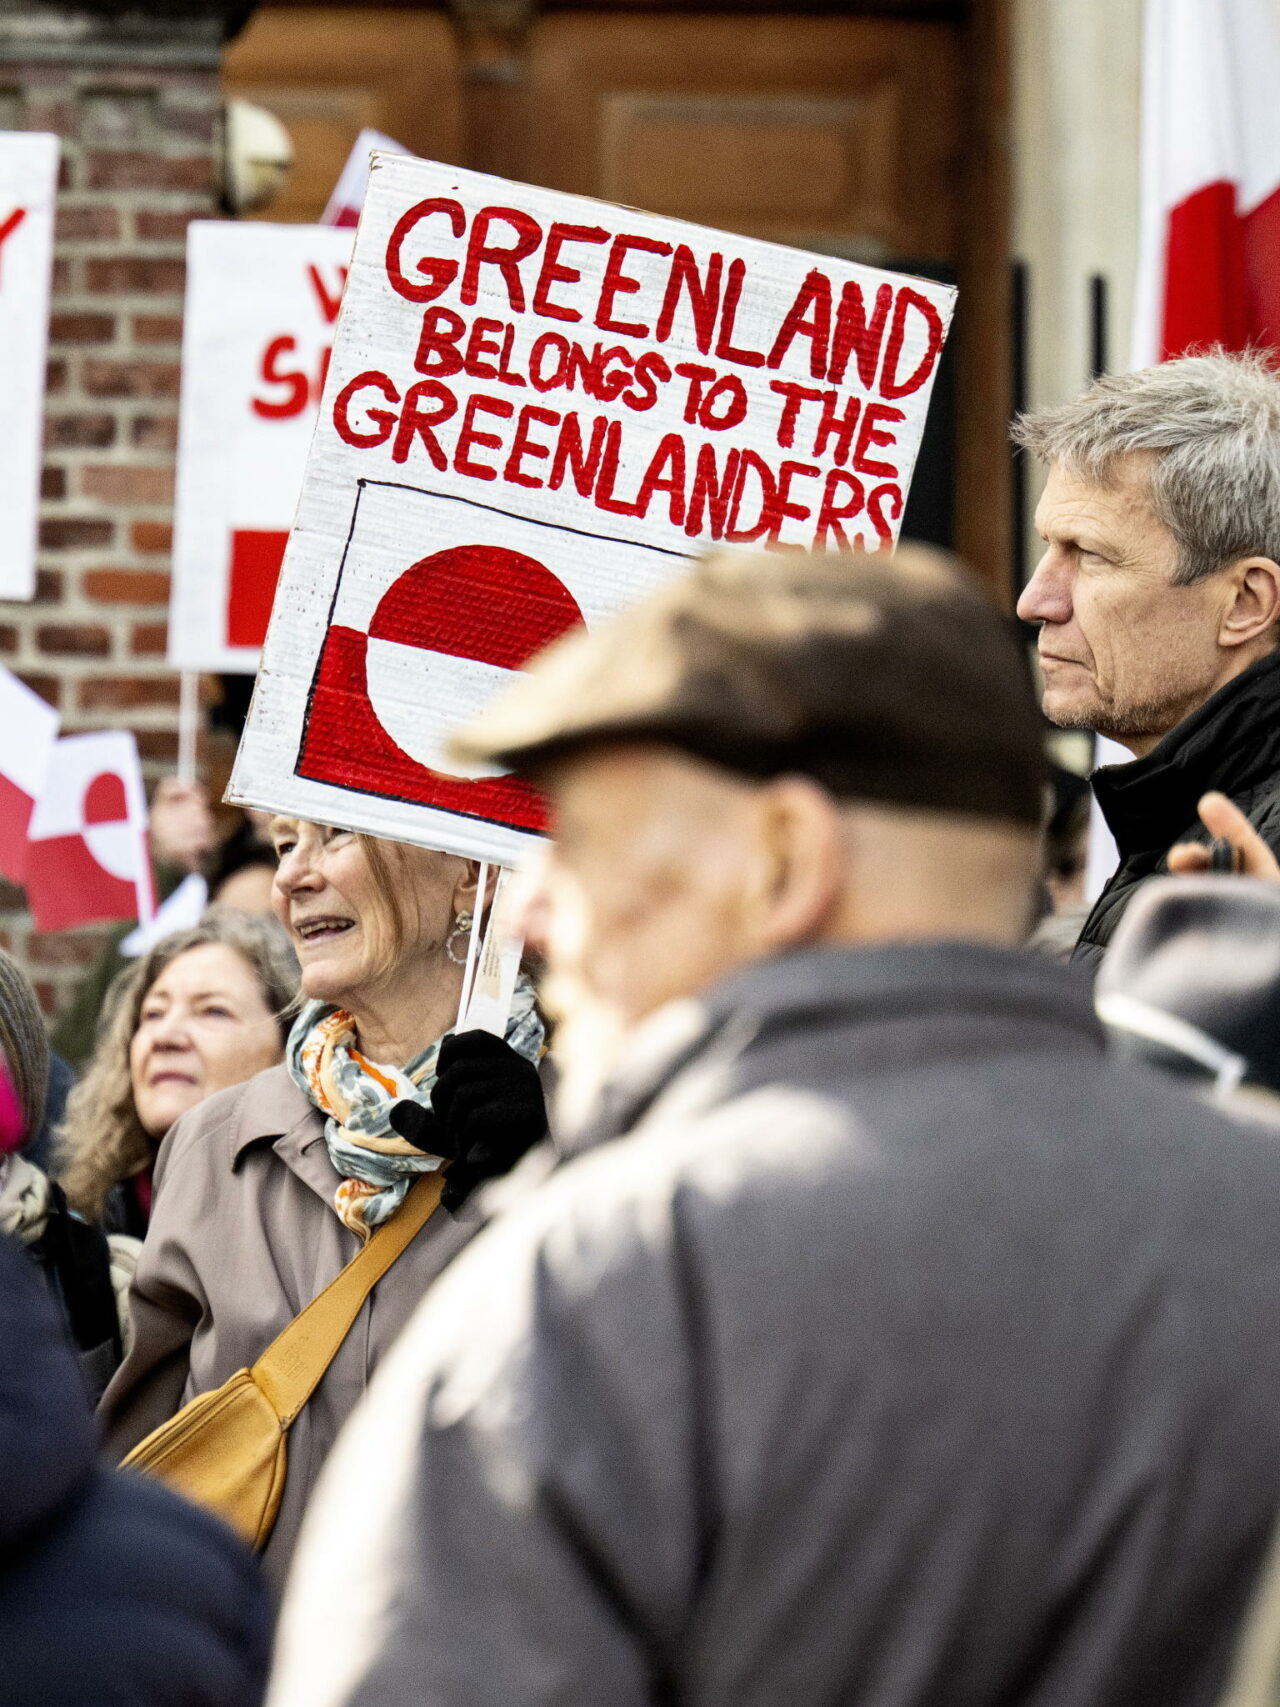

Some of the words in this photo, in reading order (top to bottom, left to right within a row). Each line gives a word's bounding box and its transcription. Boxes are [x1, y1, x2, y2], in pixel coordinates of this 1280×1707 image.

[385, 197, 945, 401] GREENLAND
[332, 369, 904, 554] GREENLANDERS
[413, 305, 673, 413] BELONGS
[673, 362, 749, 432] TO
[768, 379, 908, 479] THE
